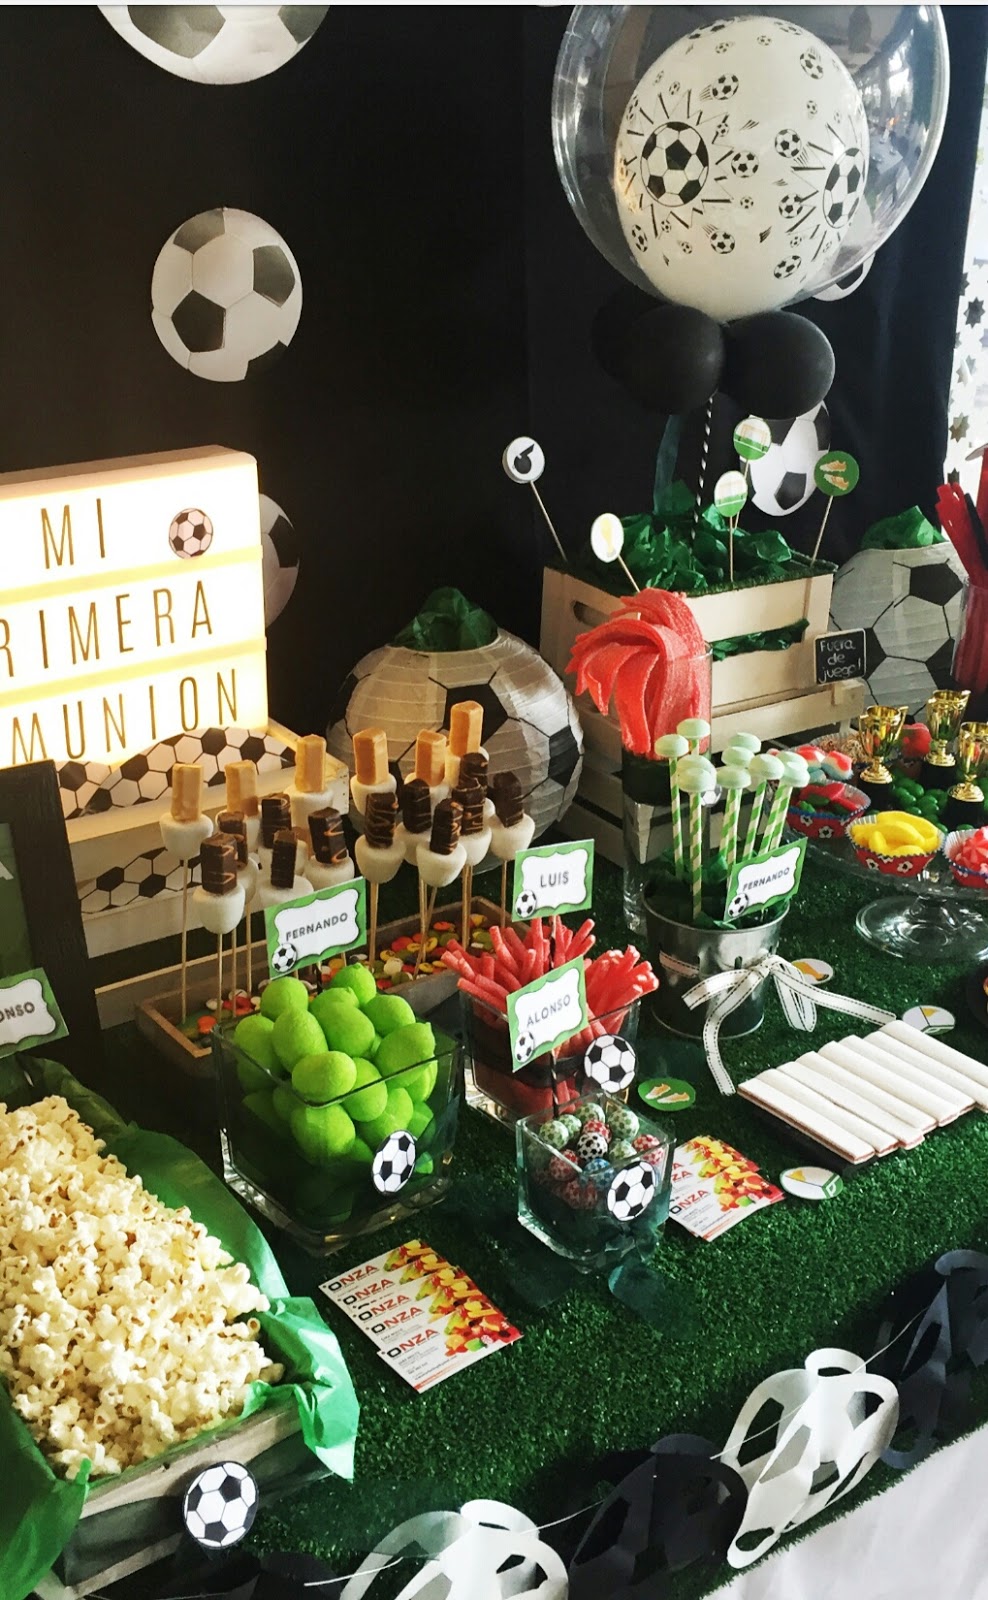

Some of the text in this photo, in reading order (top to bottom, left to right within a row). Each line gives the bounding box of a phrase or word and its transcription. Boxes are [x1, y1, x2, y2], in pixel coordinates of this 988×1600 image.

[41, 498, 105, 569] MI
[827, 653, 845, 665] de
[12, 668, 237, 765] MUNION
[540, 870, 570, 888] LUIS
[742, 867, 790, 891] FERNANDO
[286, 912, 348, 941] FERNANDO
[527, 994, 571, 1026] ALONSO
[669, 1189, 709, 1214] ONZA
[328, 1264, 378, 1292] ONZA
[343, 1278, 394, 1305] ONZA
[358, 1292, 410, 1321] ONZA
[371, 1306, 424, 1334] ONZA
[387, 1328, 438, 1358] ONZA
